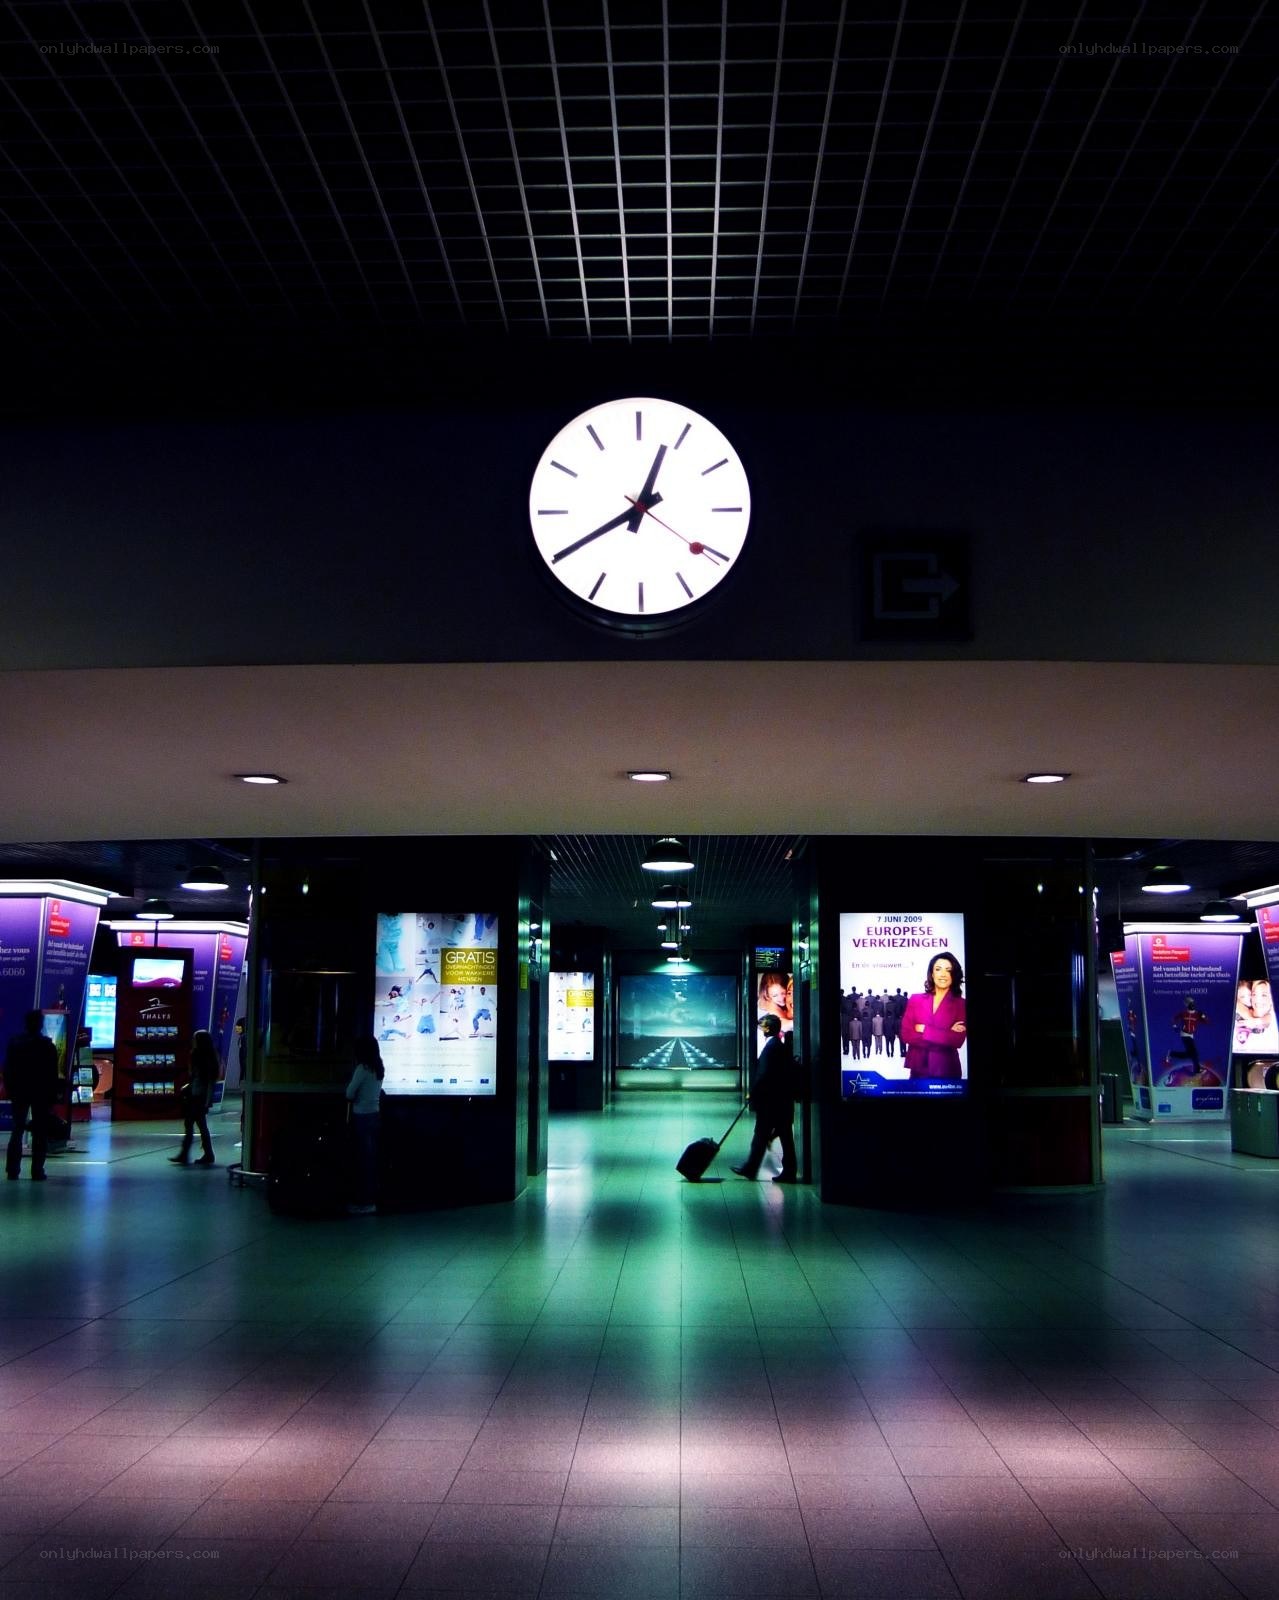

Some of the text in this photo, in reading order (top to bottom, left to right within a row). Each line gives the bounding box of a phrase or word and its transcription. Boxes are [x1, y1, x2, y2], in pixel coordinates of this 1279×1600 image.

[866, 926, 934, 936] EUROPESE
[852, 938, 948, 947] VERKIEZINGEN
[445, 951, 495, 964] GRATIS
